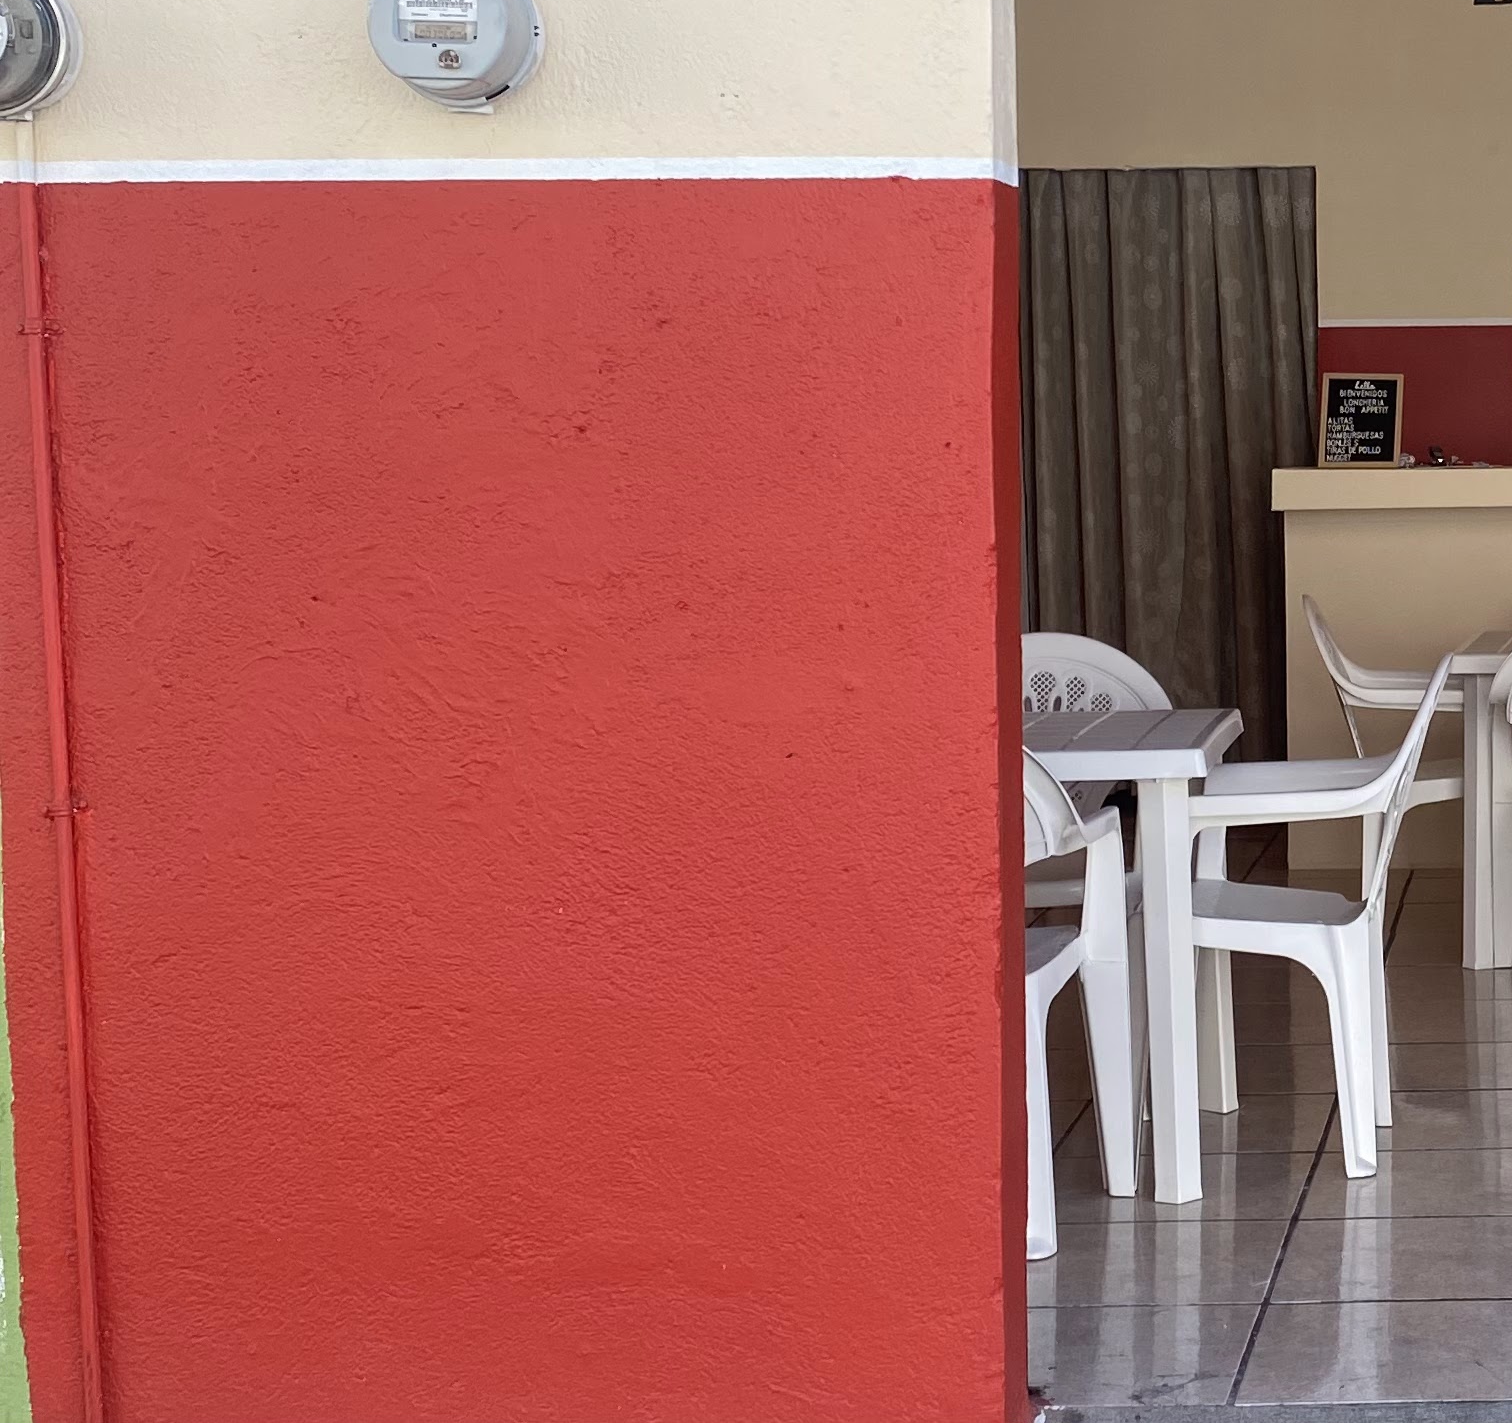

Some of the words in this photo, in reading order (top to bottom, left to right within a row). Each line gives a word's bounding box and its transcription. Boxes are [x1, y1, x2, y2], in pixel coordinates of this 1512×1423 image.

[1339, 389, 1388, 397] BIENVENIDOS
[1339, 405, 1356, 414] BON
[1360, 406, 1389, 414] APPETIT
[1327, 416, 1354, 424] ALITAS
[1327, 424, 1355, 432] TORTAS
[1327, 431, 1384, 439] HAMBURGUESAS
[1326, 446, 1346, 454] TIRAS
[1348, 446, 1357, 454] DE
[1358, 446, 1381, 454] POLLO
